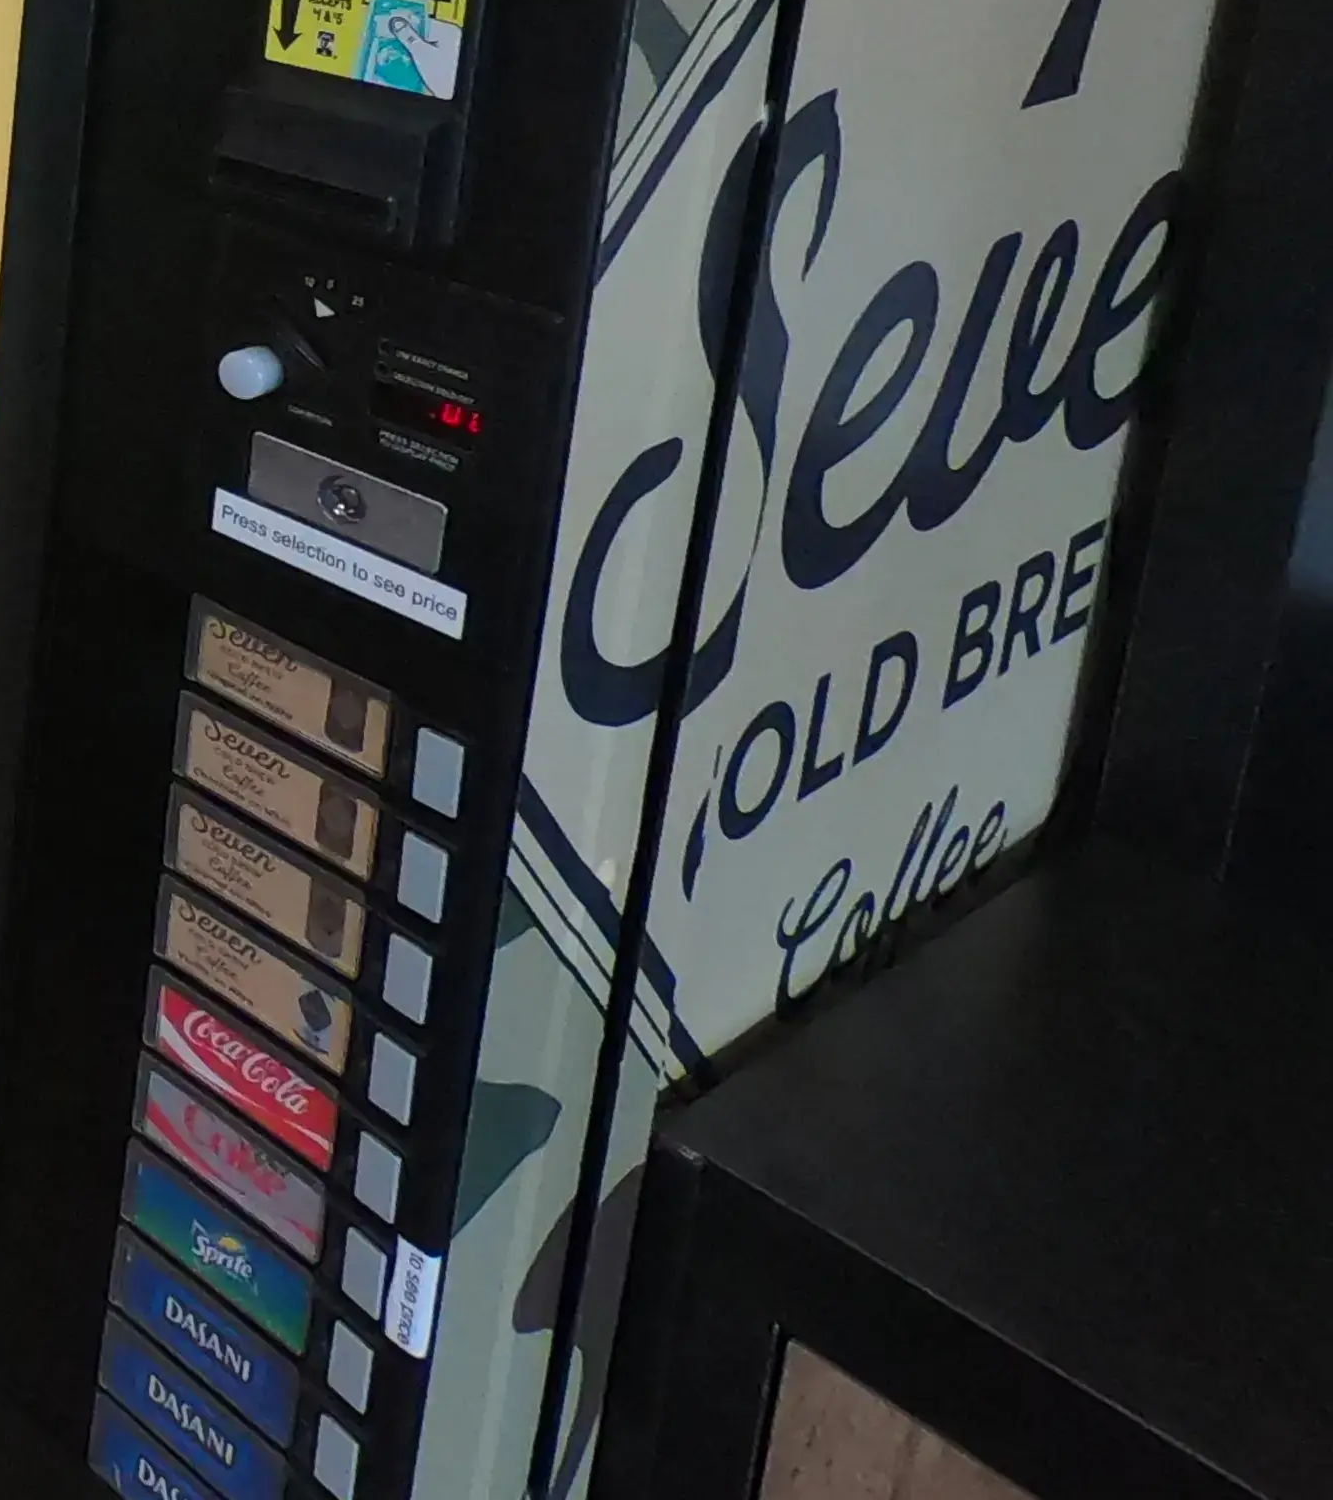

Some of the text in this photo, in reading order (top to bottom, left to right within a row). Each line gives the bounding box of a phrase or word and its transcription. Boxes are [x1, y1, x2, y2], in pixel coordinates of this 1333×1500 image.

[561, 88, 1189, 728] Seve
[221, 503, 458, 622] Press selection to see price
[945, 516, 1107, 713] BRE
[192, 1234, 254, 1280] Sprite
[165, 1295, 251, 1383] DASANI
[148, 1374, 235, 1467] DASANI
